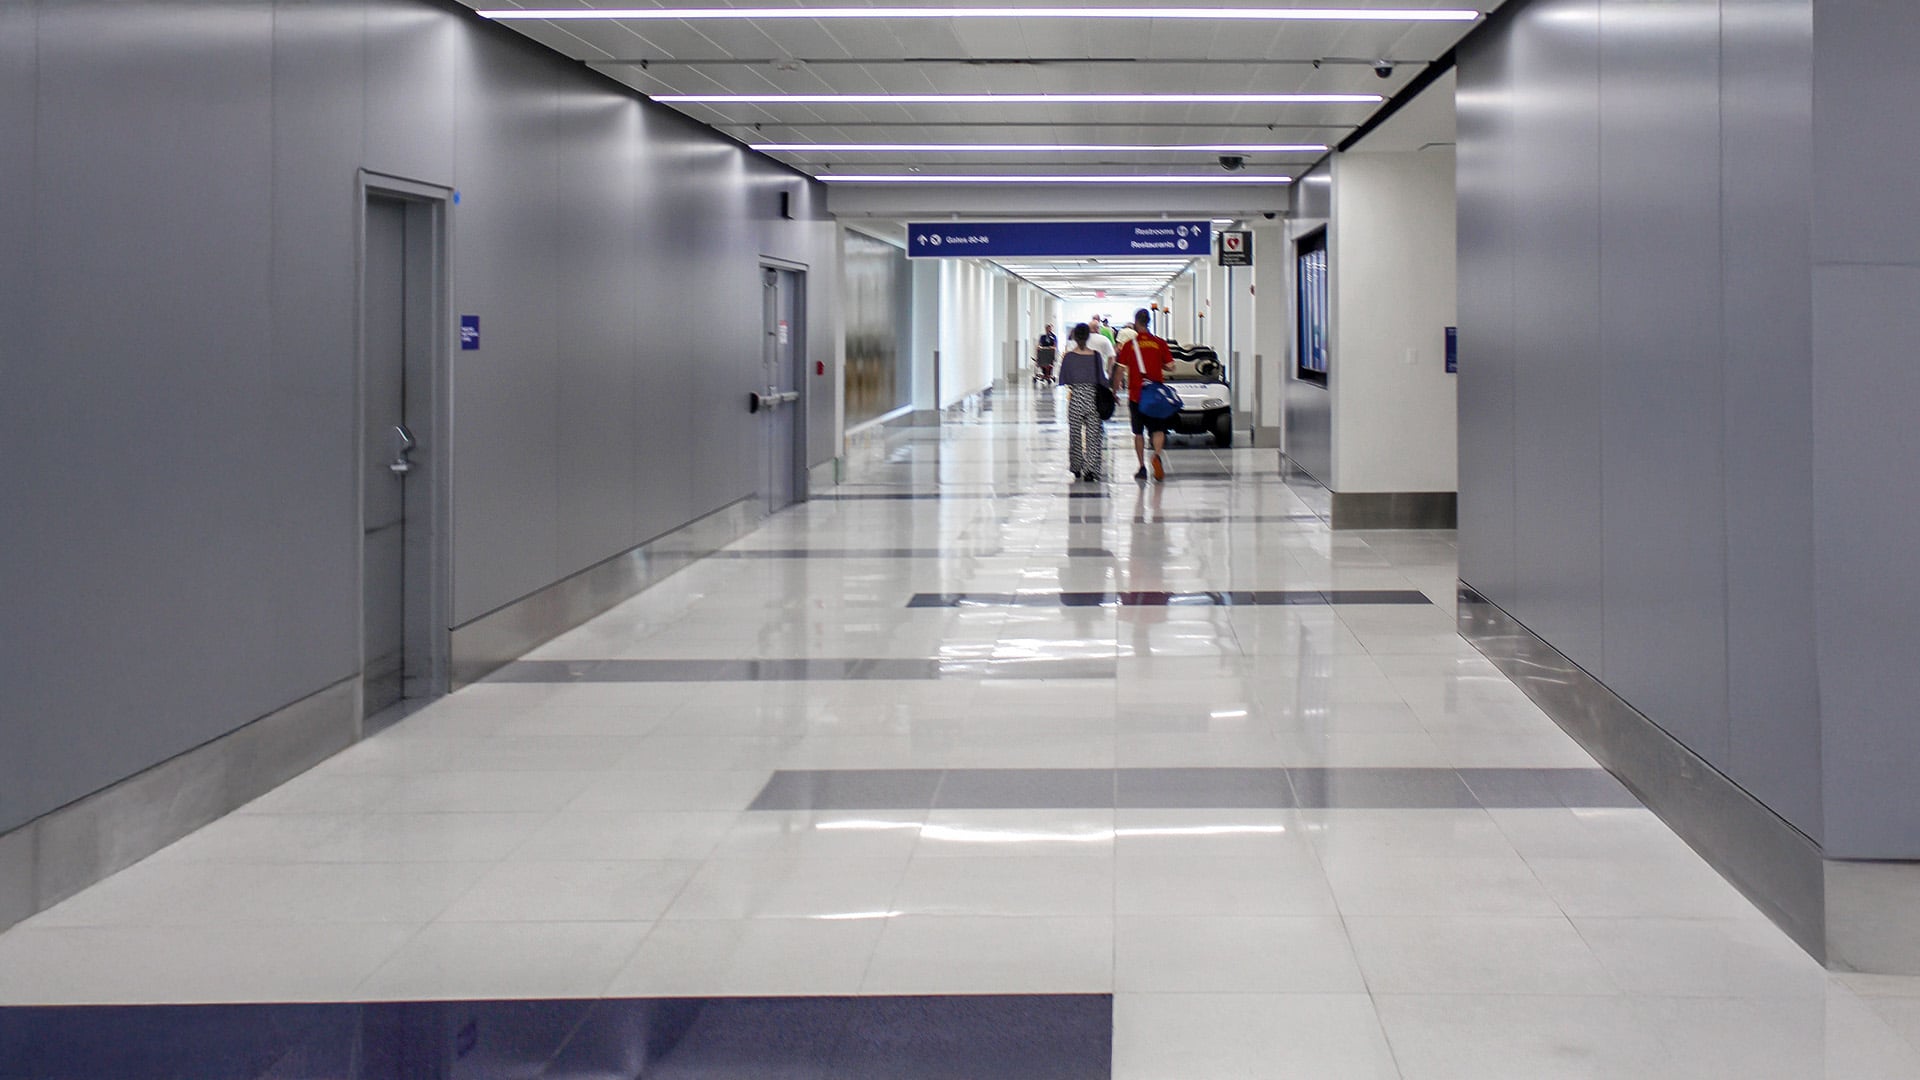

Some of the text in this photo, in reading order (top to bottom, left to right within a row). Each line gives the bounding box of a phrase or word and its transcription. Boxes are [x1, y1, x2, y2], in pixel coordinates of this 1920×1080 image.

[1134, 227, 1175, 236] Restrooms
[945, 235, 968, 244] Gates
[1130, 240, 1175, 249] Restaurants
